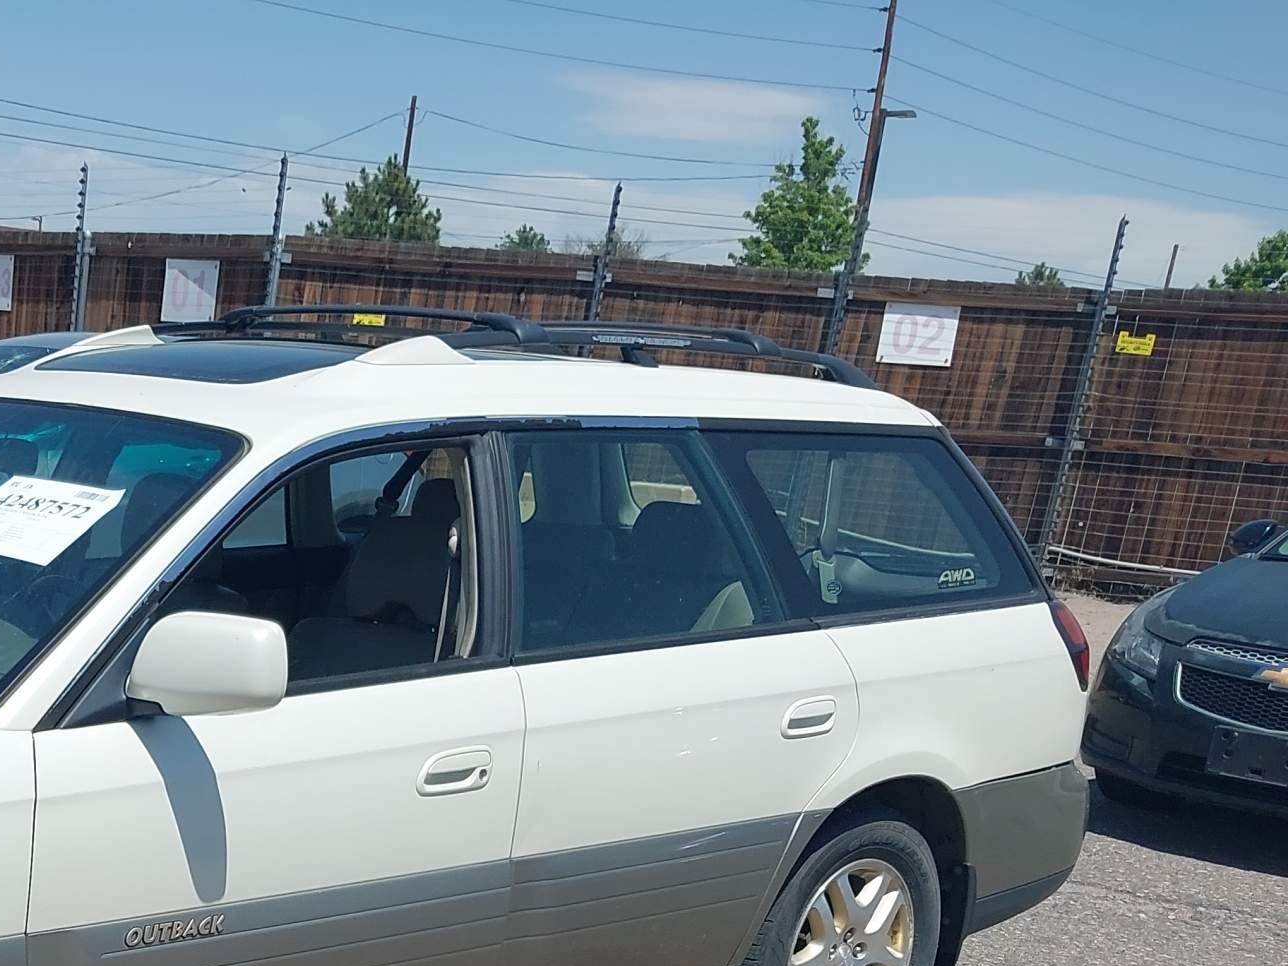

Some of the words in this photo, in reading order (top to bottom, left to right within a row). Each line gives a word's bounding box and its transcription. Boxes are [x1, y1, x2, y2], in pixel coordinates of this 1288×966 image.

[171, 269, 206, 313] 01
[892, 314, 945, 356] 02
[938, 567, 975, 583] AWD
[124, 913, 226, 947] OUTBACK
